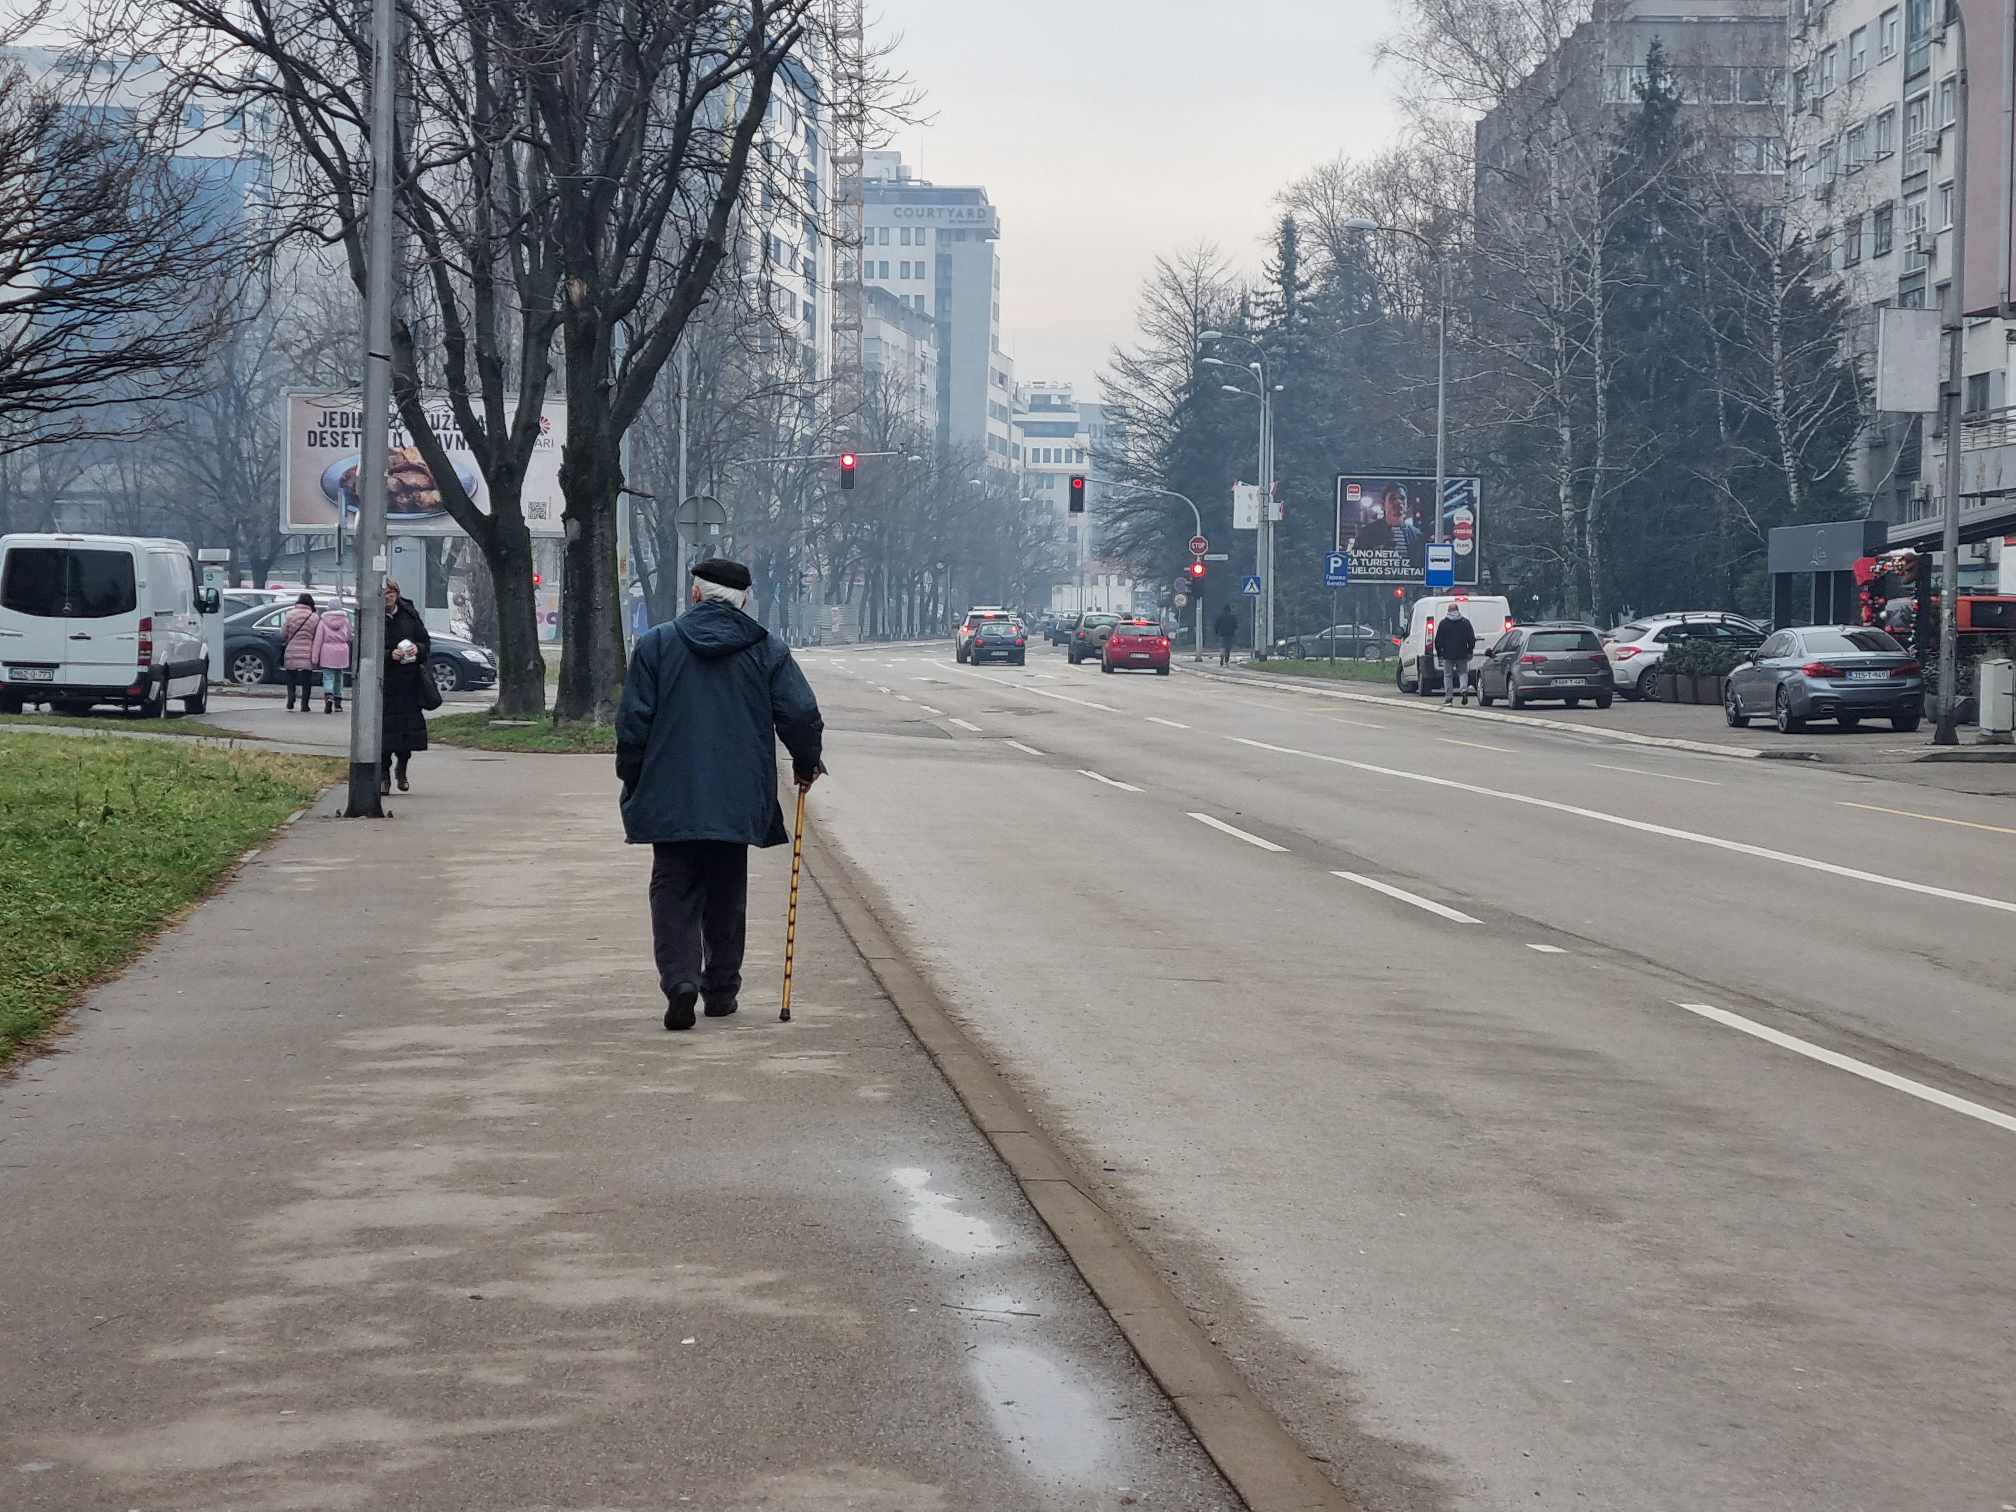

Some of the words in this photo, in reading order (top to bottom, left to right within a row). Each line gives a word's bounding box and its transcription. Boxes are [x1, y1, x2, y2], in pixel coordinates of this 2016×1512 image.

[894, 207, 986, 219] COURTYARD
[1191, 542, 1206, 550] STOP
[1330, 557, 1342, 574] P
[1361, 559, 1400, 567] TURISTE
[1402, 559, 1410, 567] IZ
